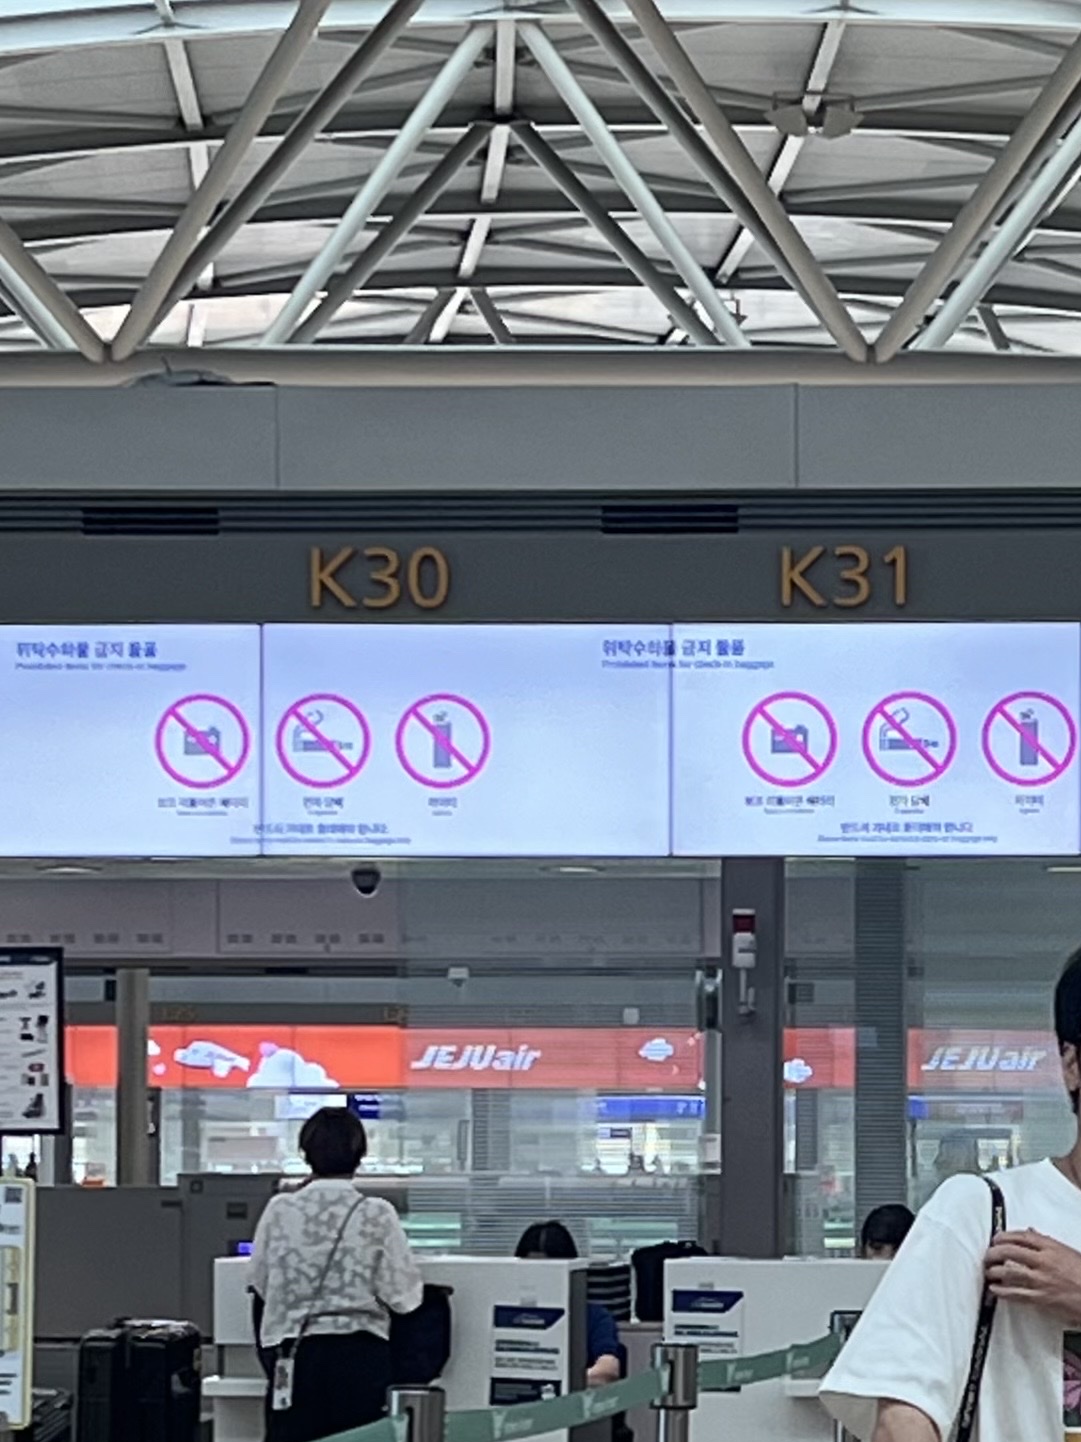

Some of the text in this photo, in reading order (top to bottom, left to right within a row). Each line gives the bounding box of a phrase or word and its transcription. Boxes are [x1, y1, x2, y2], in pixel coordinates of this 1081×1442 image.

[310, 546, 450, 609] K30
[780, 545, 908, 607] K31
[681, 639, 712, 657] 금지
[411, 1044, 542, 1071] JEJUair
